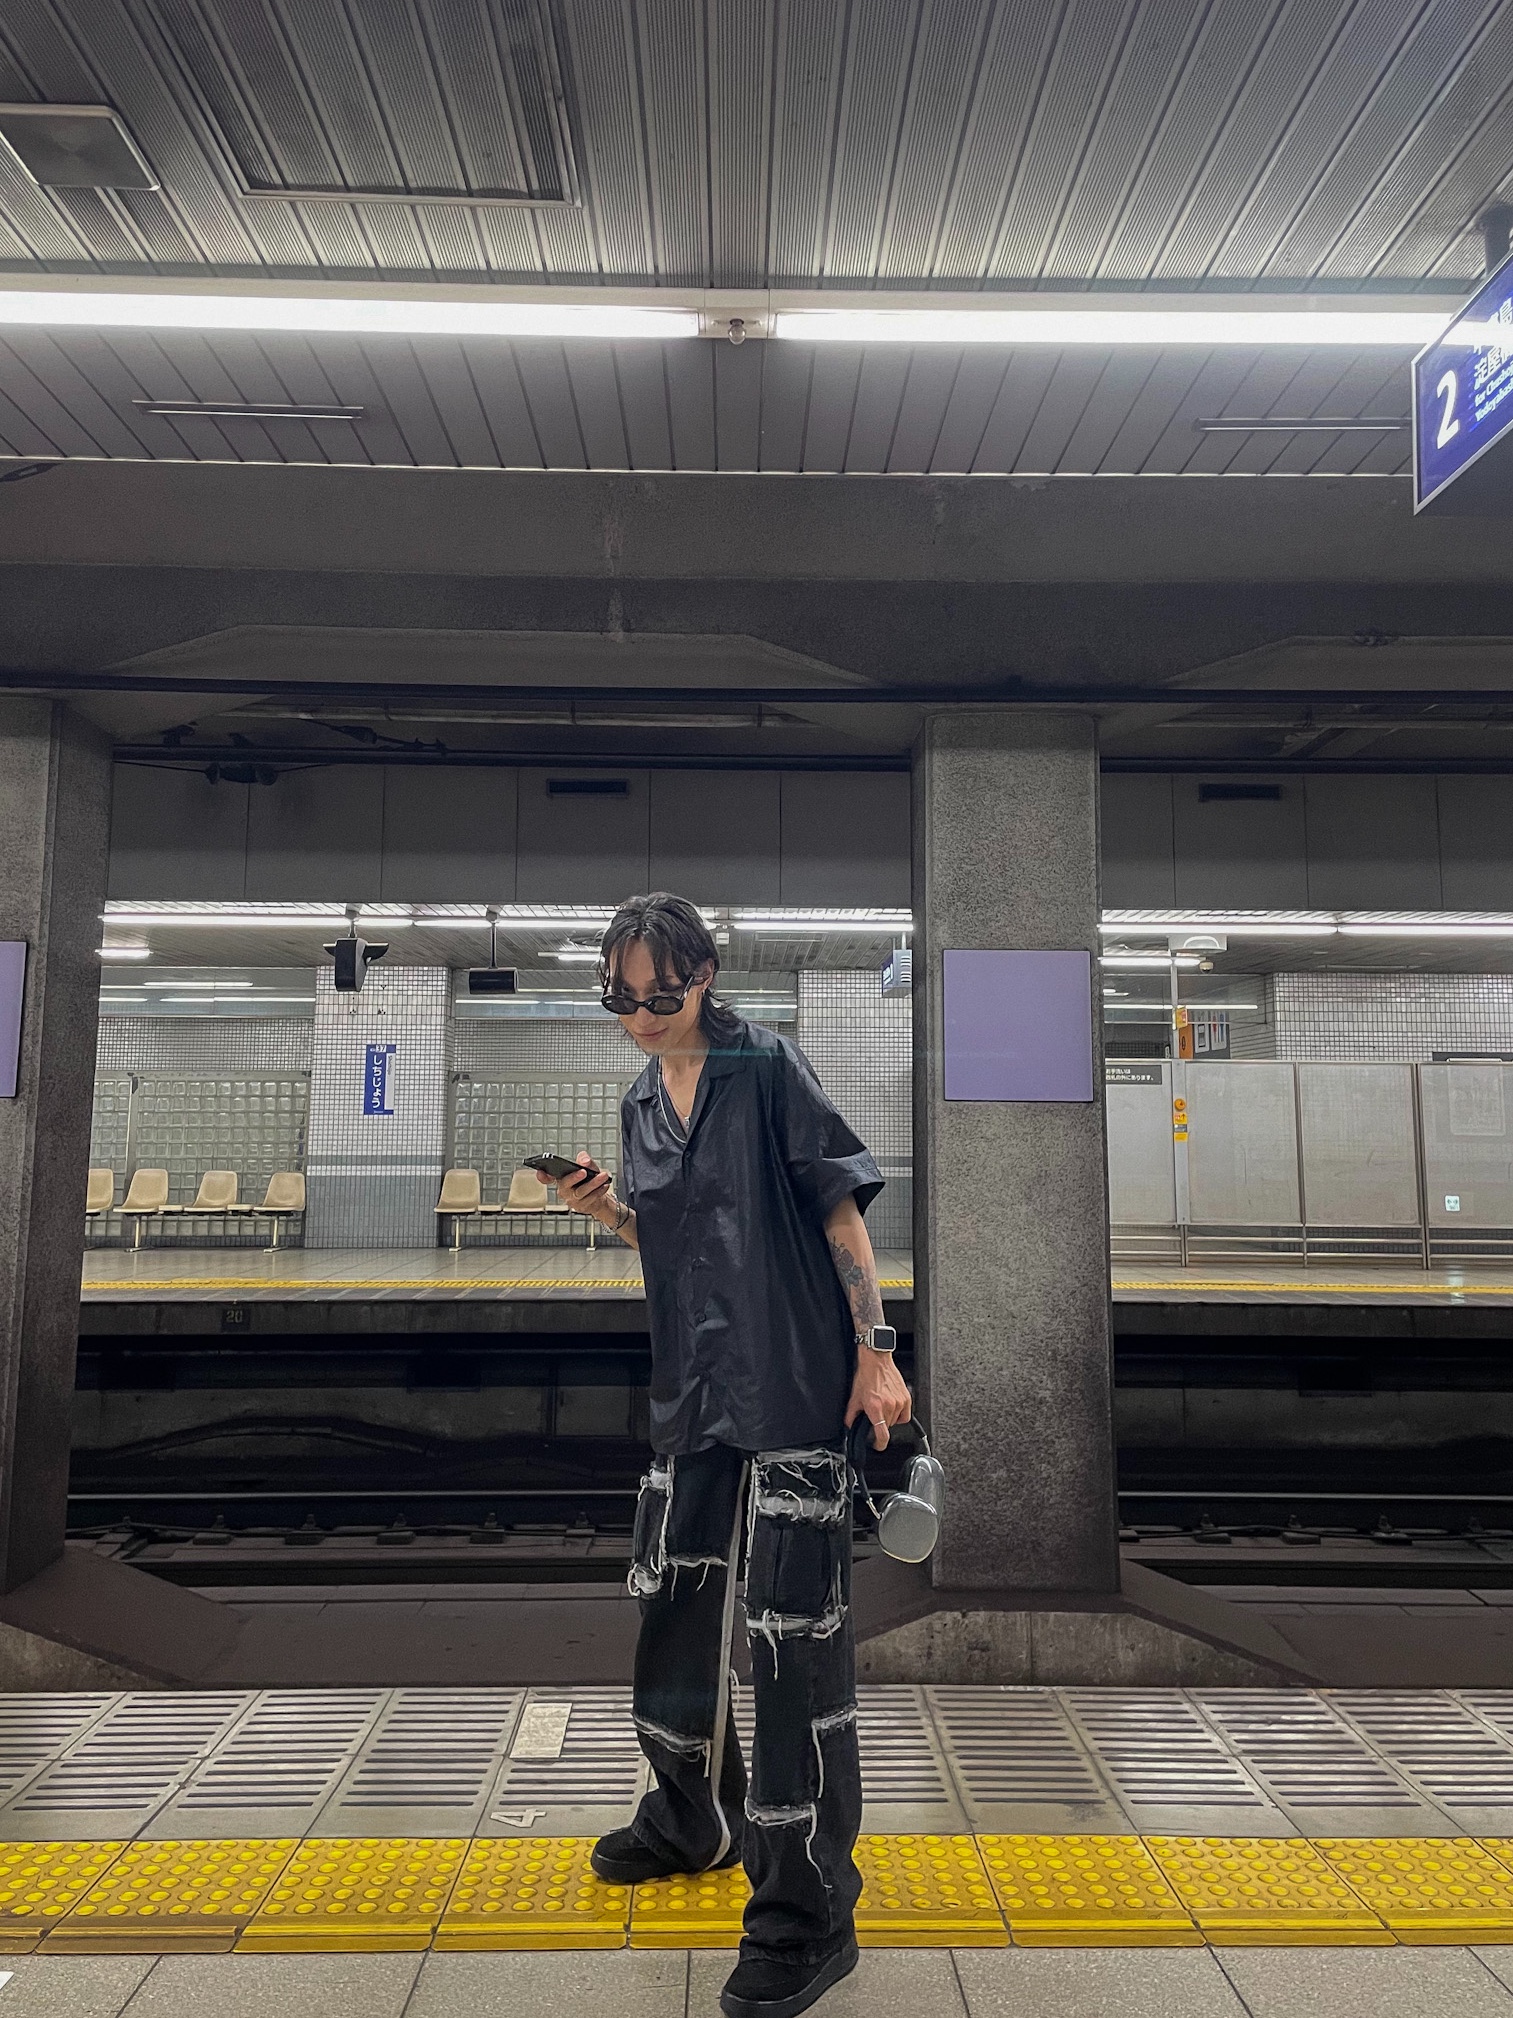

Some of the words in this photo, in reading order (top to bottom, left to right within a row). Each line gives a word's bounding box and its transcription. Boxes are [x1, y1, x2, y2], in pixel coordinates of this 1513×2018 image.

[1474, 390, 1486, 407] for
[1436, 370, 1460, 450] 2
[371, 1054, 383, 1109] しちじょう
[226, 1310, 243, 1323] 20
[490, 1808, 547, 1829] 4
